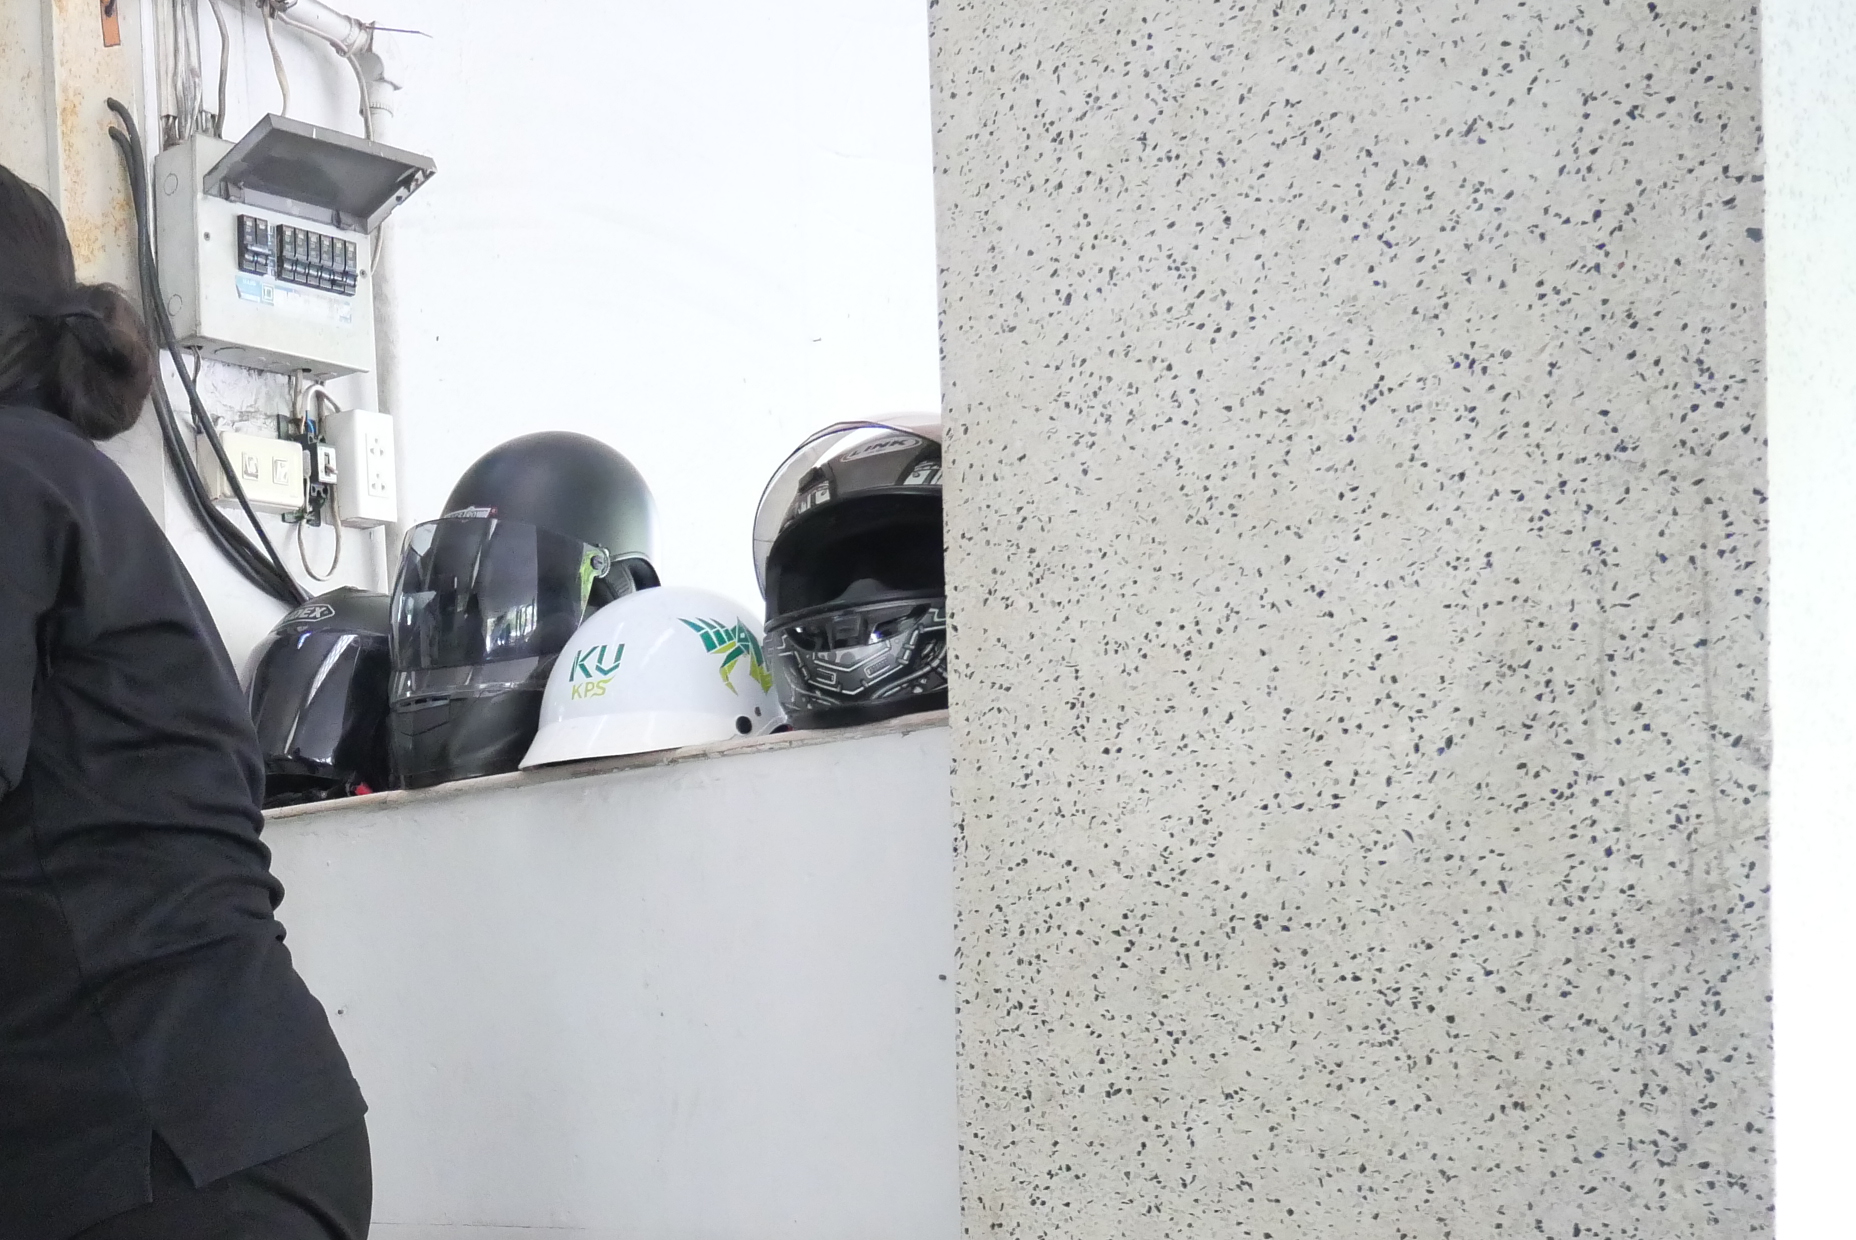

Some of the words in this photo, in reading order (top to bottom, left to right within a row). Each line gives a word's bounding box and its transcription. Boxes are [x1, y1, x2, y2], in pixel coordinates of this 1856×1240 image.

[849, 439, 909, 457] LINK
[569, 643, 625, 682] KU
[572, 675, 616, 700] KPS
